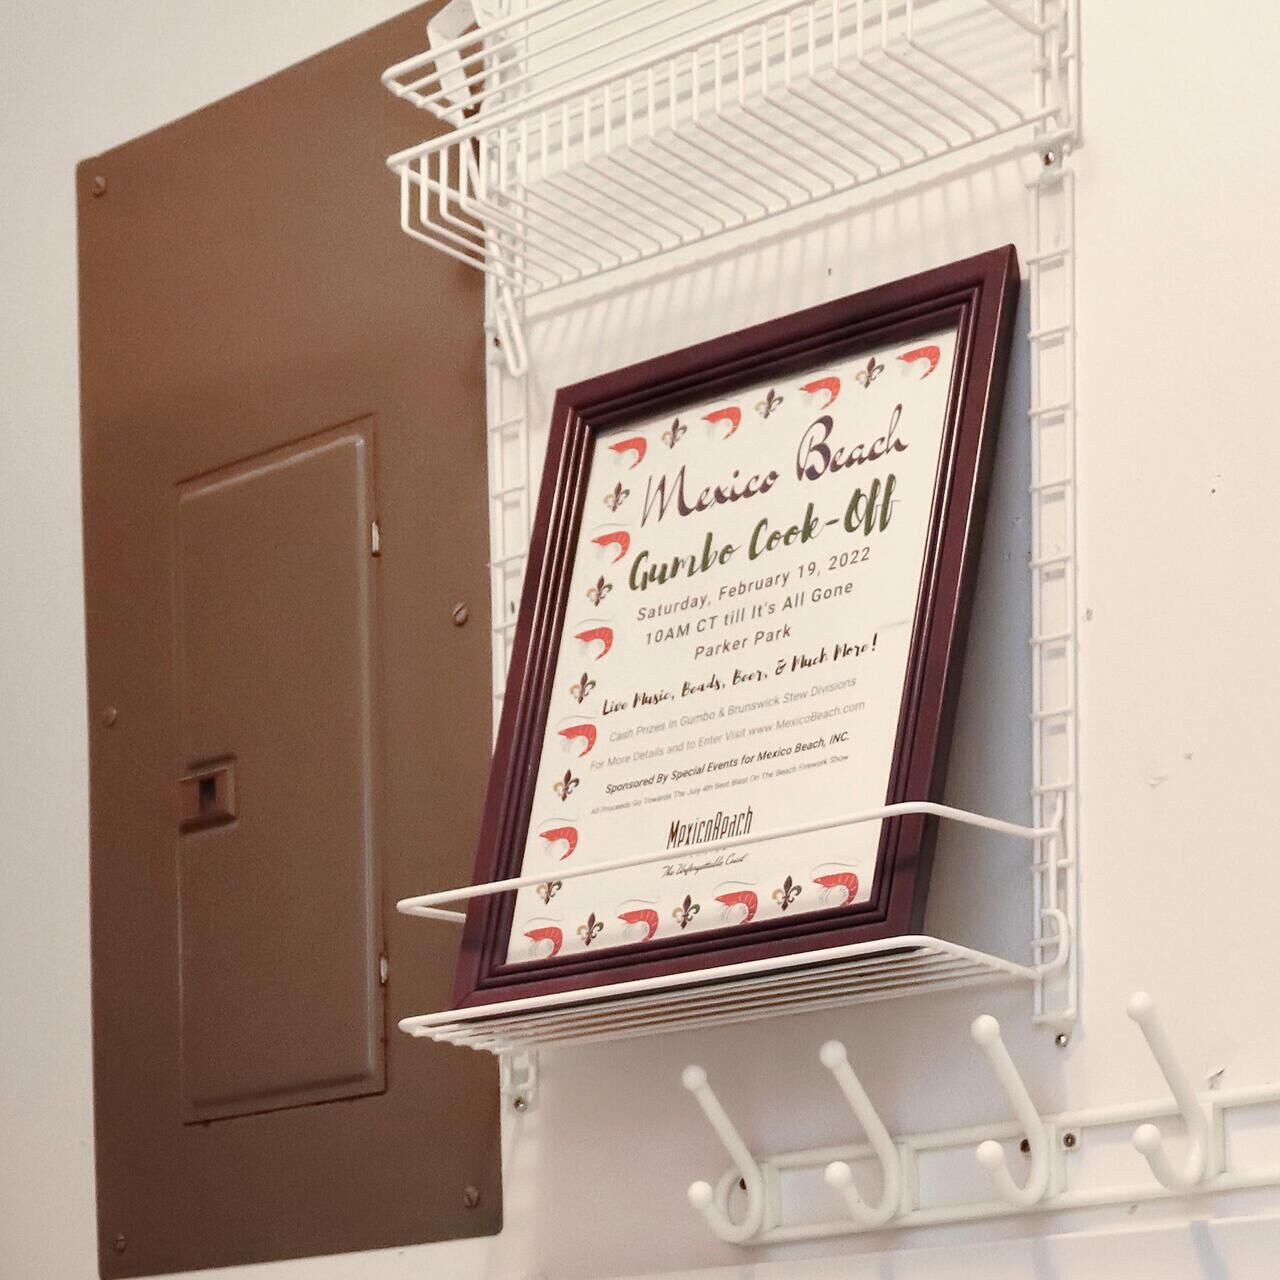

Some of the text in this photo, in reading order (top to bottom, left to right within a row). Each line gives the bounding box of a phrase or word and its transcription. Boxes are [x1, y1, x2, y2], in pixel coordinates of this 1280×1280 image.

[641, 403, 909, 528] Mexico Beach
[628, 473, 901, 591] Gumbo Cook-Off
[637, 546, 871, 621] Saturday, February 19, 2022
[645, 582, 854, 646] 10AM CT till It's All Gone
[694, 623, 792, 660] Parker Park
[602, 699, 628, 716] Live
[632, 689, 675, 709] Music,
[681, 673, 726, 698] Beads,
[732, 667, 768, 686] Beer,
[791, 646, 828, 672] Much
[609, 729, 634, 742] Cash
[636, 721, 666, 737] Prizes
[680, 710, 716, 727] Gumbo
[727, 695, 781, 717] Brunswick
[782, 688, 809, 704] Stew
[810, 677, 857, 698] Divisions
[590, 759, 606, 771] For
[608, 754, 632, 768] More
[633, 746, 665, 762] Details
[667, 741, 685, 754] and
[686, 739, 697, 750] to
[698, 733, 723, 748] Enter
[725, 726, 747, 742] Visit
[604, 730, 851, 796] Sponsored By Special Events for Mexico Beach, INC.
